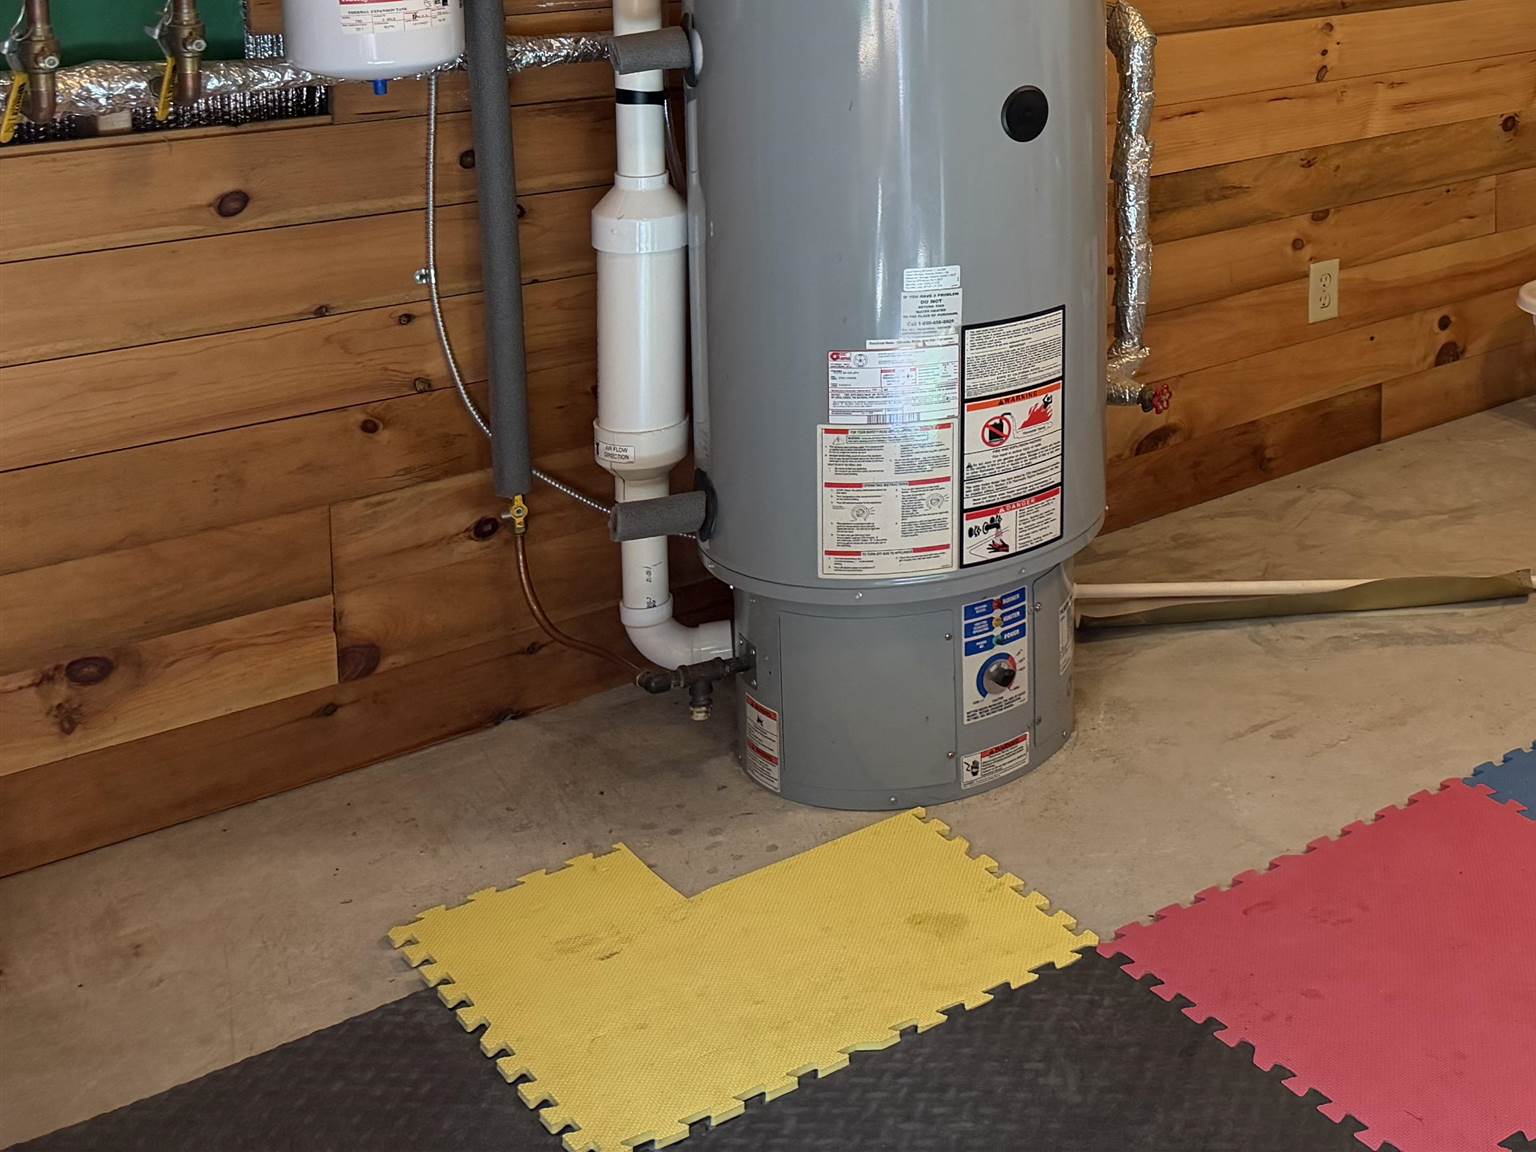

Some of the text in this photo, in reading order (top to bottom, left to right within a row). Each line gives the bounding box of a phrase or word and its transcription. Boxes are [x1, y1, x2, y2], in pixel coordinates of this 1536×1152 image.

[1004, 391, 1038, 404] WARNING
[604, 451, 630, 460] DIRECTION
[1006, 498, 1036, 510] DANGER
[1003, 629, 1020, 639] POWER
